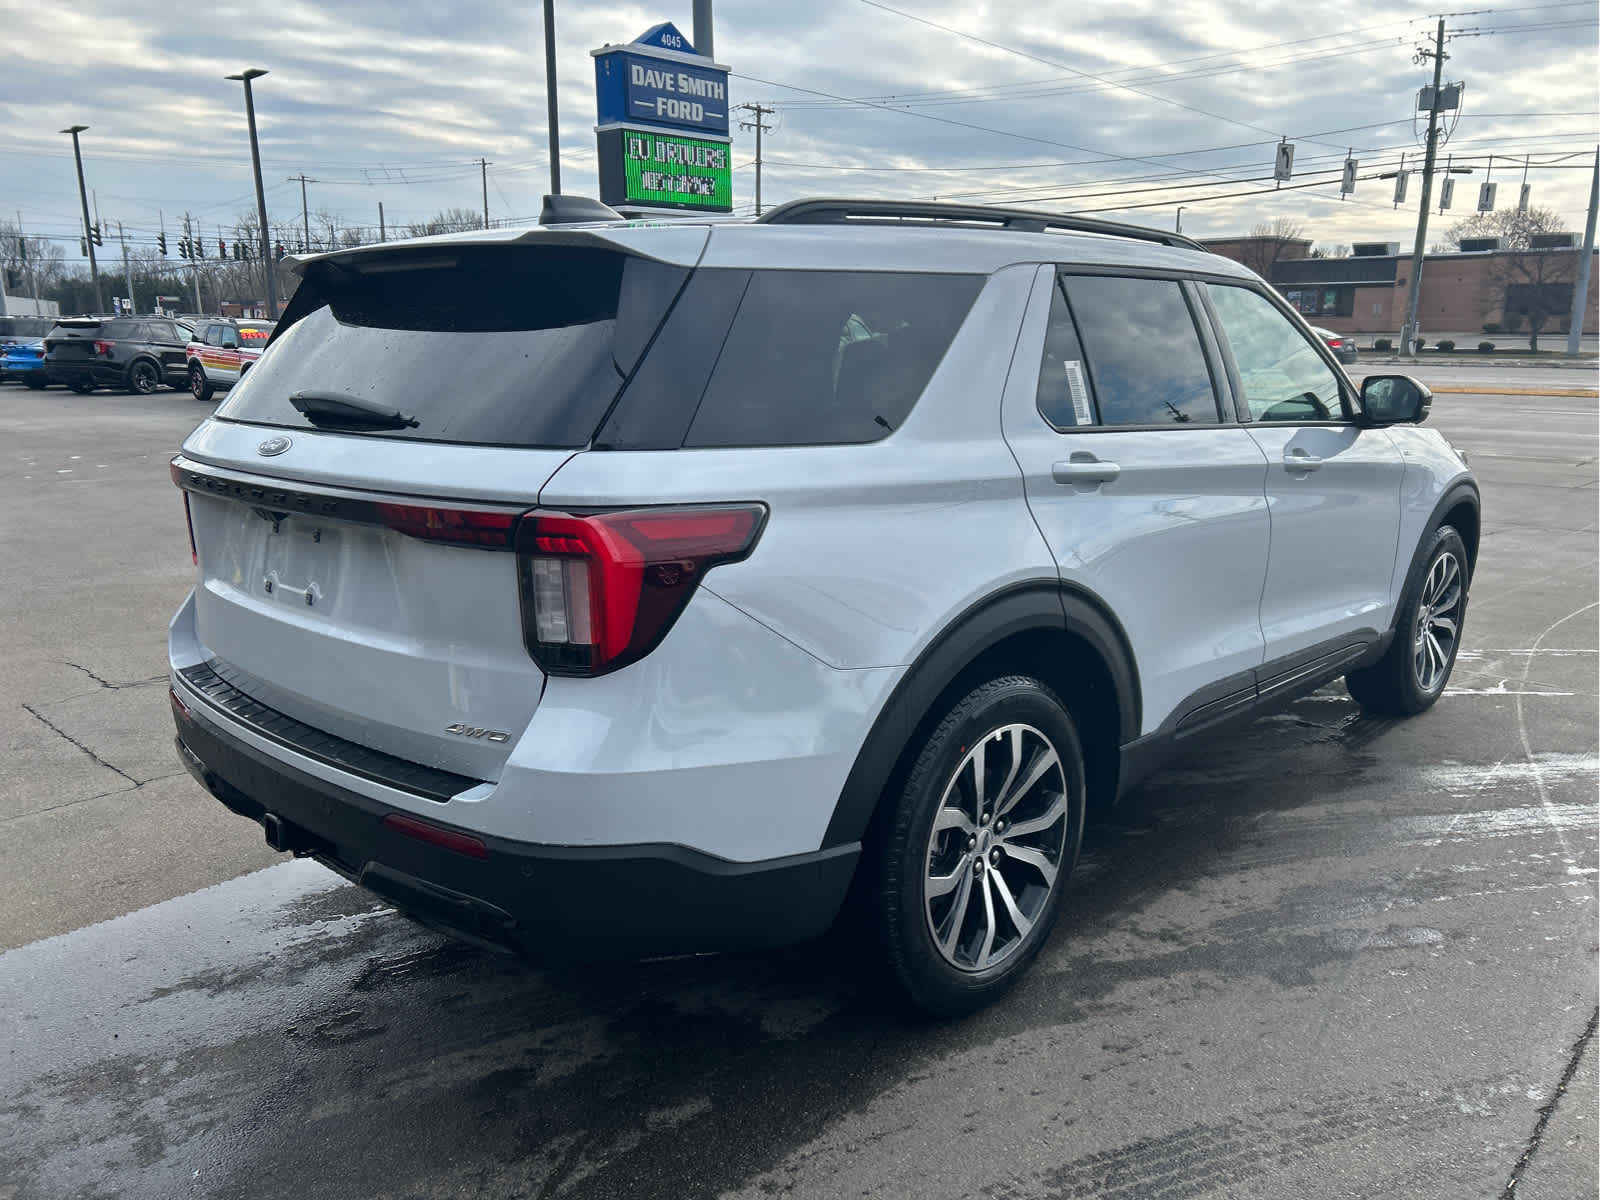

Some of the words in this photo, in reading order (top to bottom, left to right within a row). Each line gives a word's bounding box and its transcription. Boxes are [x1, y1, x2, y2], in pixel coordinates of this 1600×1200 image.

[661, 33, 681, 48] 4045
[631, 64, 675, 91] DAVE
[678, 73, 724, 100] SMITH
[656, 96, 704, 122] FORD
[444, 722, 512, 744] 4WD
